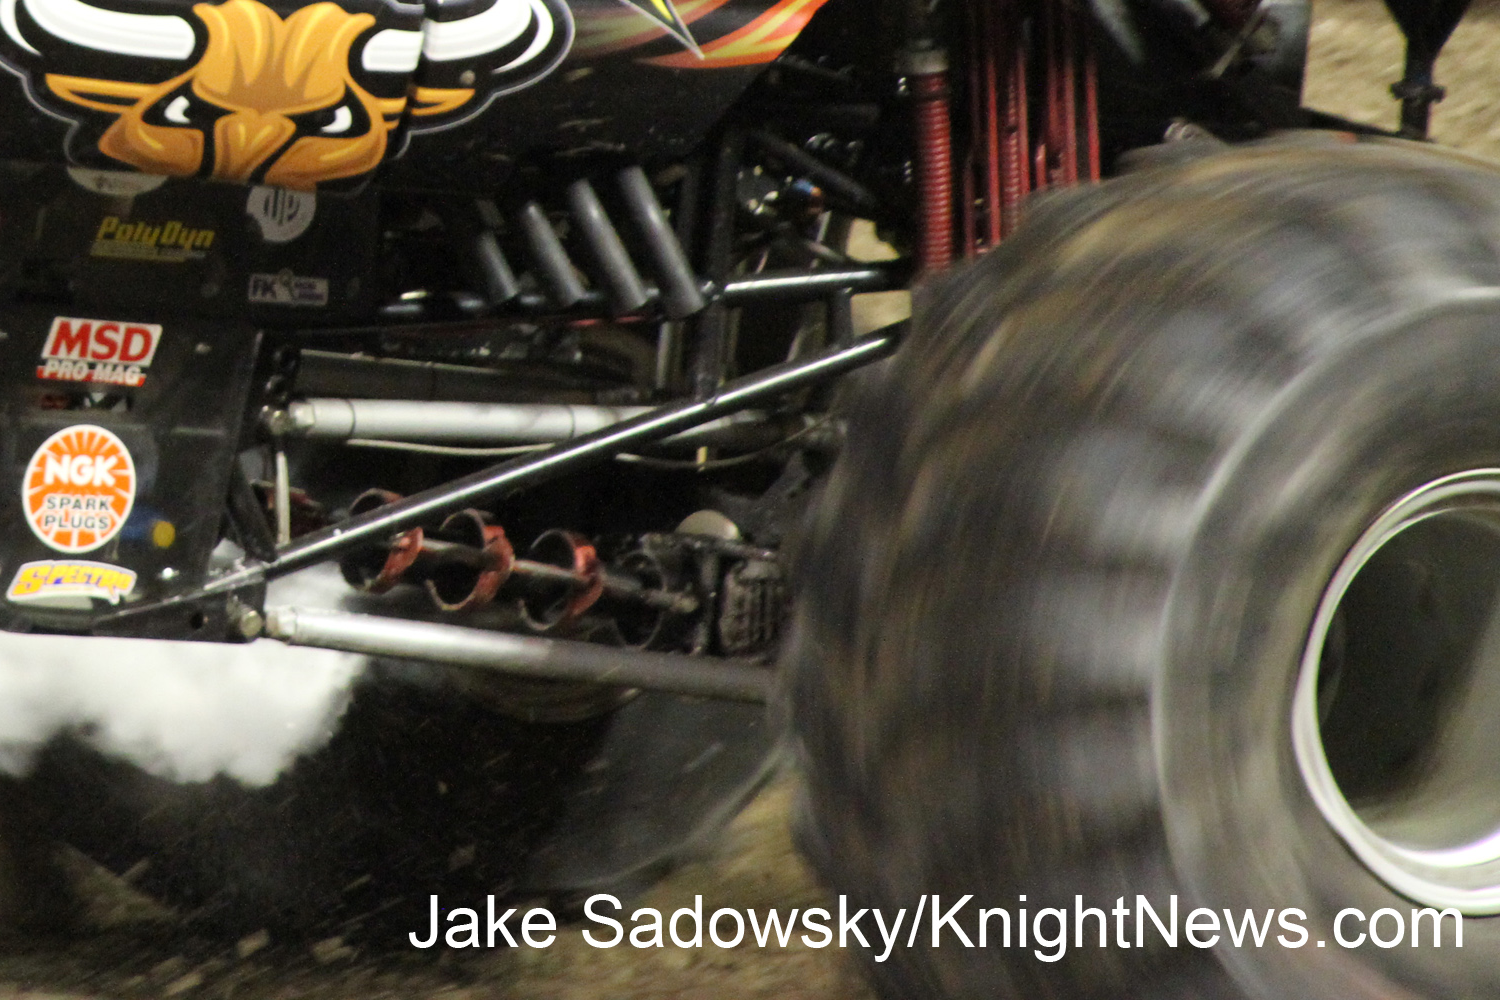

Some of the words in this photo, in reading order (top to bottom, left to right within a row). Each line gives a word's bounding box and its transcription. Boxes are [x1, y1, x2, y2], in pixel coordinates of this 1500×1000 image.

[50, 321, 153, 362] MSD
[43, 360, 89, 381] PRO
[92, 364, 142, 386] MAG
[44, 454, 118, 487] NGK
[46, 497, 110, 511] SPARK
[44, 514, 109, 530] PLUGS
